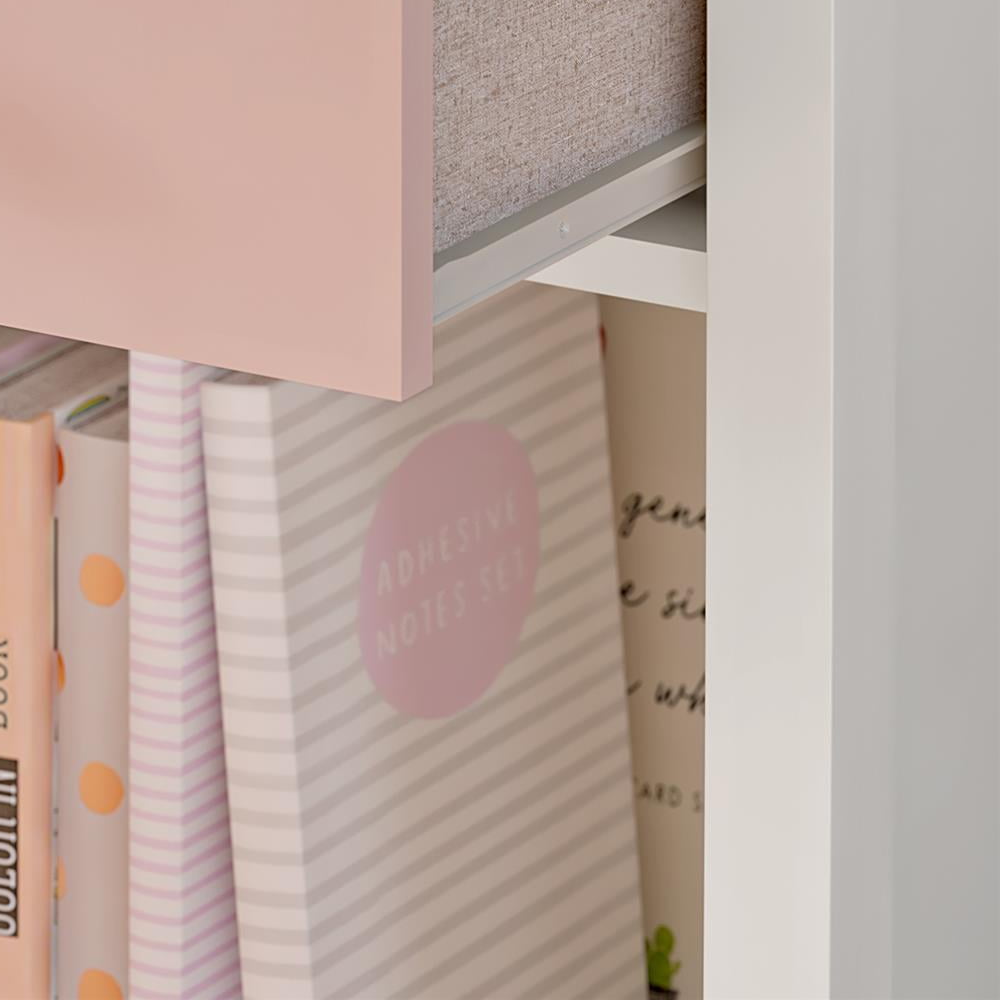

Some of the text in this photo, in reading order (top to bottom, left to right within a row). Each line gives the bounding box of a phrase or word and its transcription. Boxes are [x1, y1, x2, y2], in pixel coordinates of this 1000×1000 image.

[376, 489, 518, 598] ADHESIVE
[376, 546, 526, 661] NOTES SET
